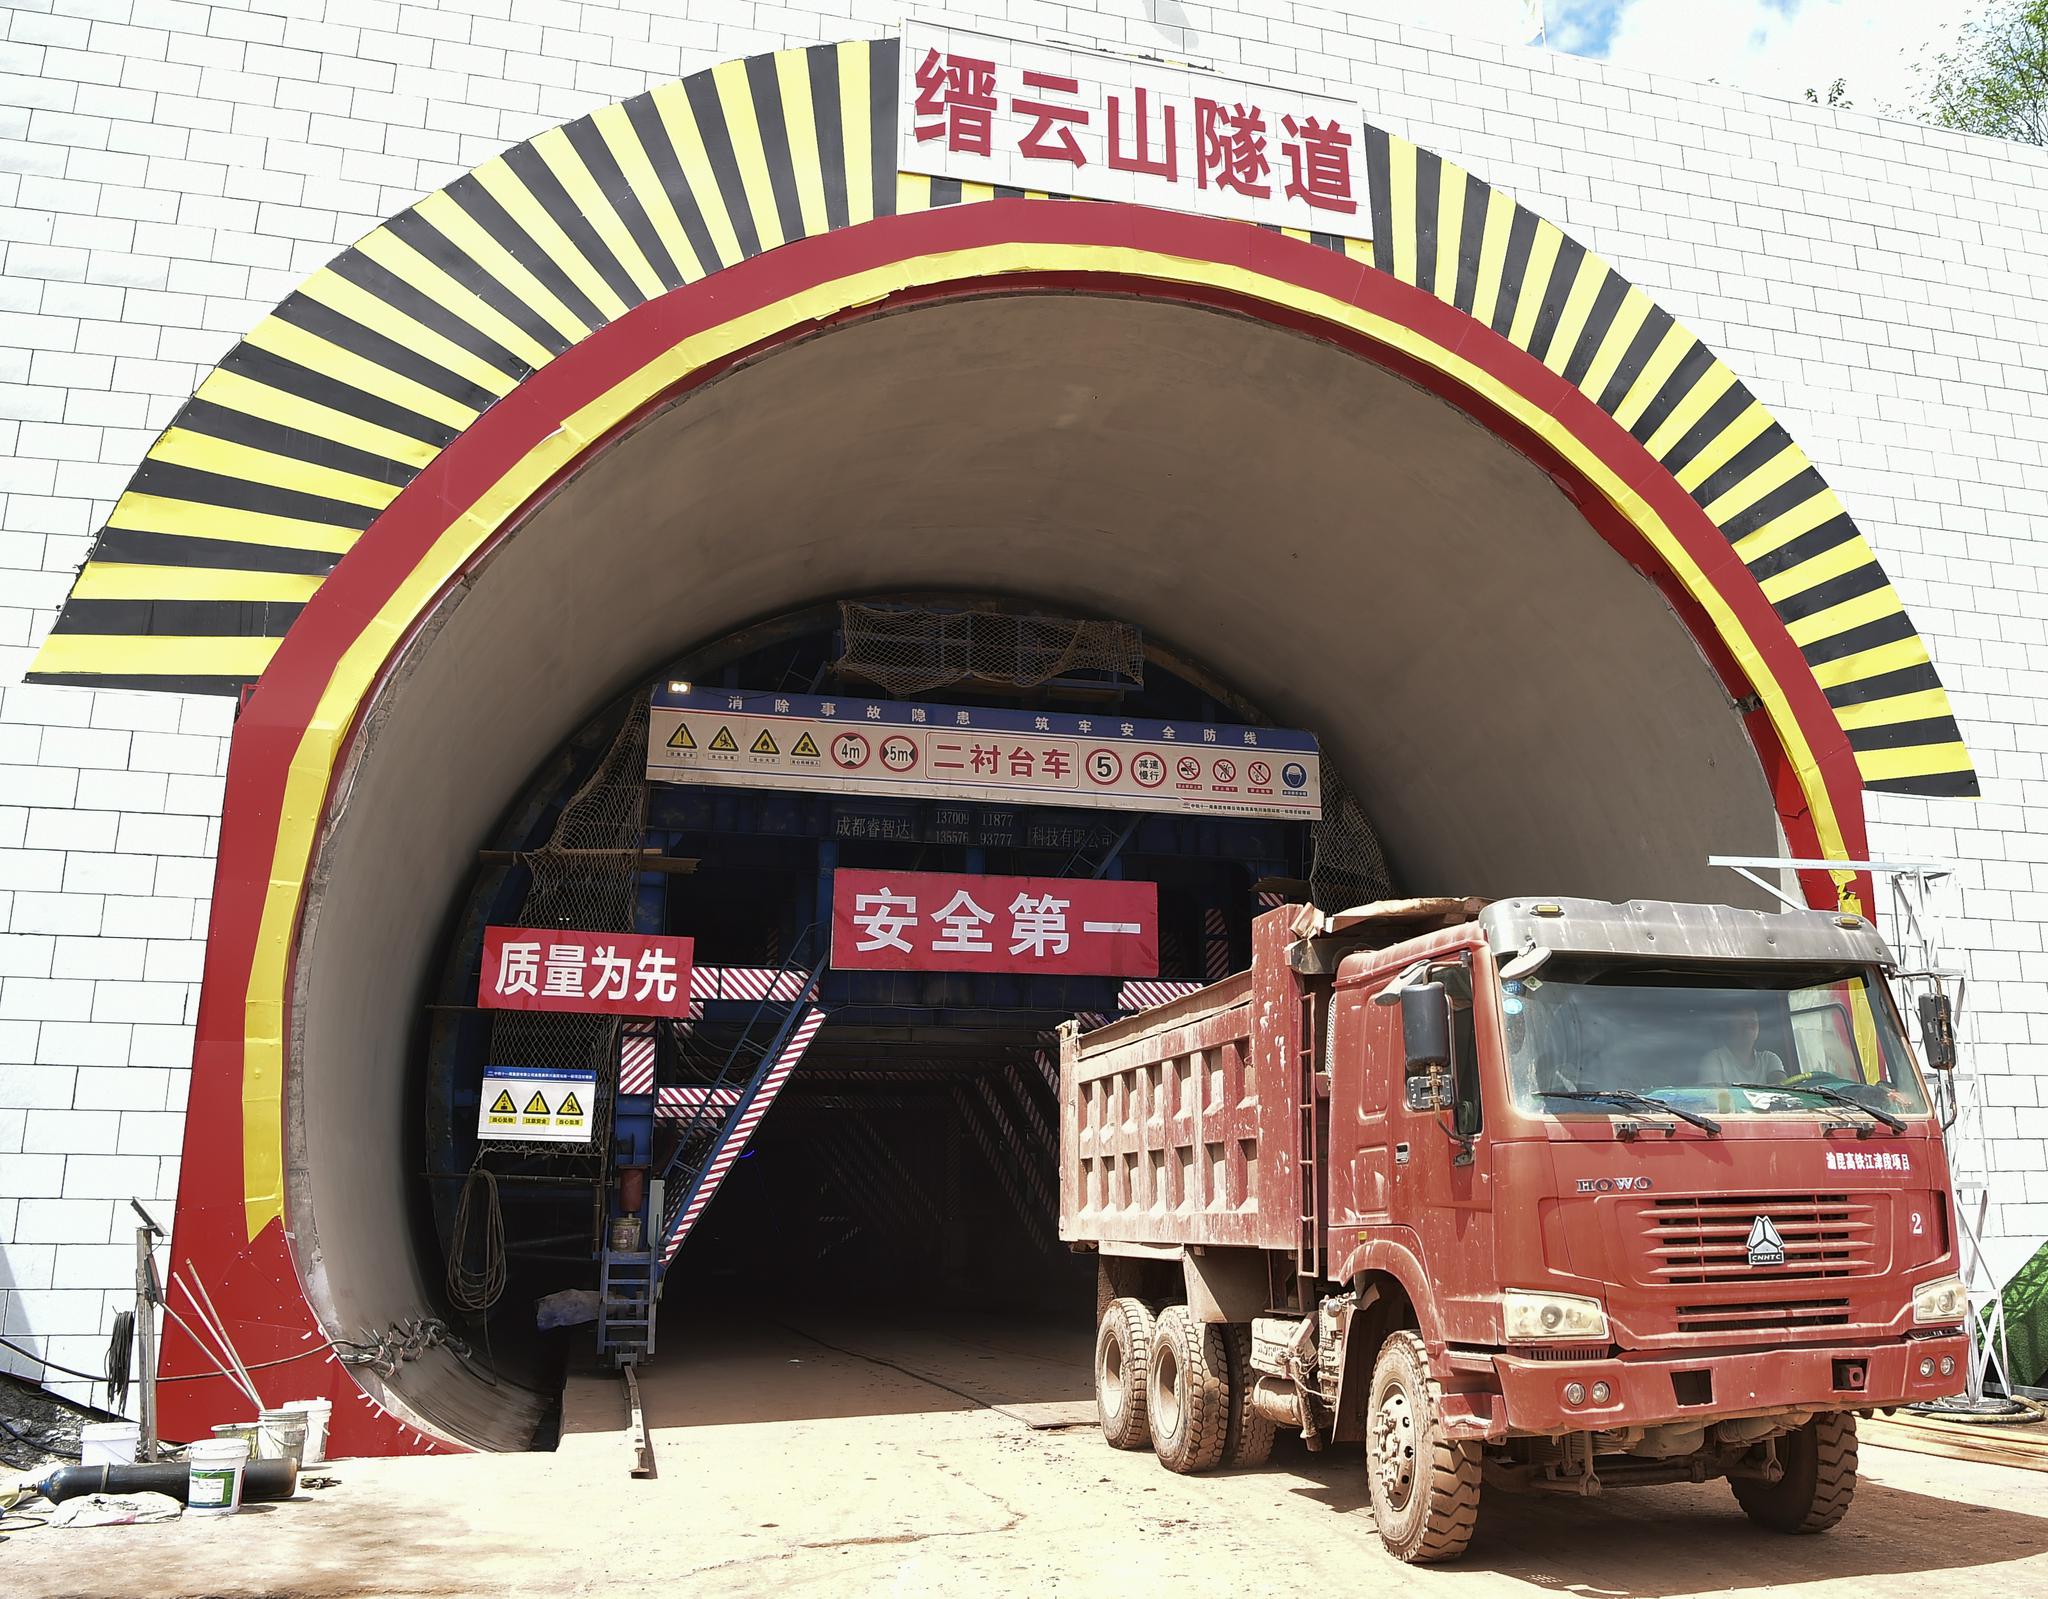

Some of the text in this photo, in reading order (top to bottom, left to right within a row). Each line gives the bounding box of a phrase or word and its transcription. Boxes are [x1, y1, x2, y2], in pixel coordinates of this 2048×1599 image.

[914, 47, 1357, 214] 缙云山隧道
[728, 695, 1258, 745] 消除事故隐患 筑牢安全防线
[841, 745, 861, 759] 4m
[889, 746, 909, 763] 5m
[934, 743, 1071, 779] 二衬台车
[1096, 756, 1112, 777] 5
[1138, 759, 1159, 769] 减速
[1138, 770, 1159, 780] 慢行
[836, 815, 1113, 848] 成都睿智达 科技有限公司
[853, 887, 1141, 957] 安全第一
[494, 942, 678, 1002] 质量为先
[1576, 1176, 1653, 1193] HOWO
[1911, 1213, 1923, 1235] 2
